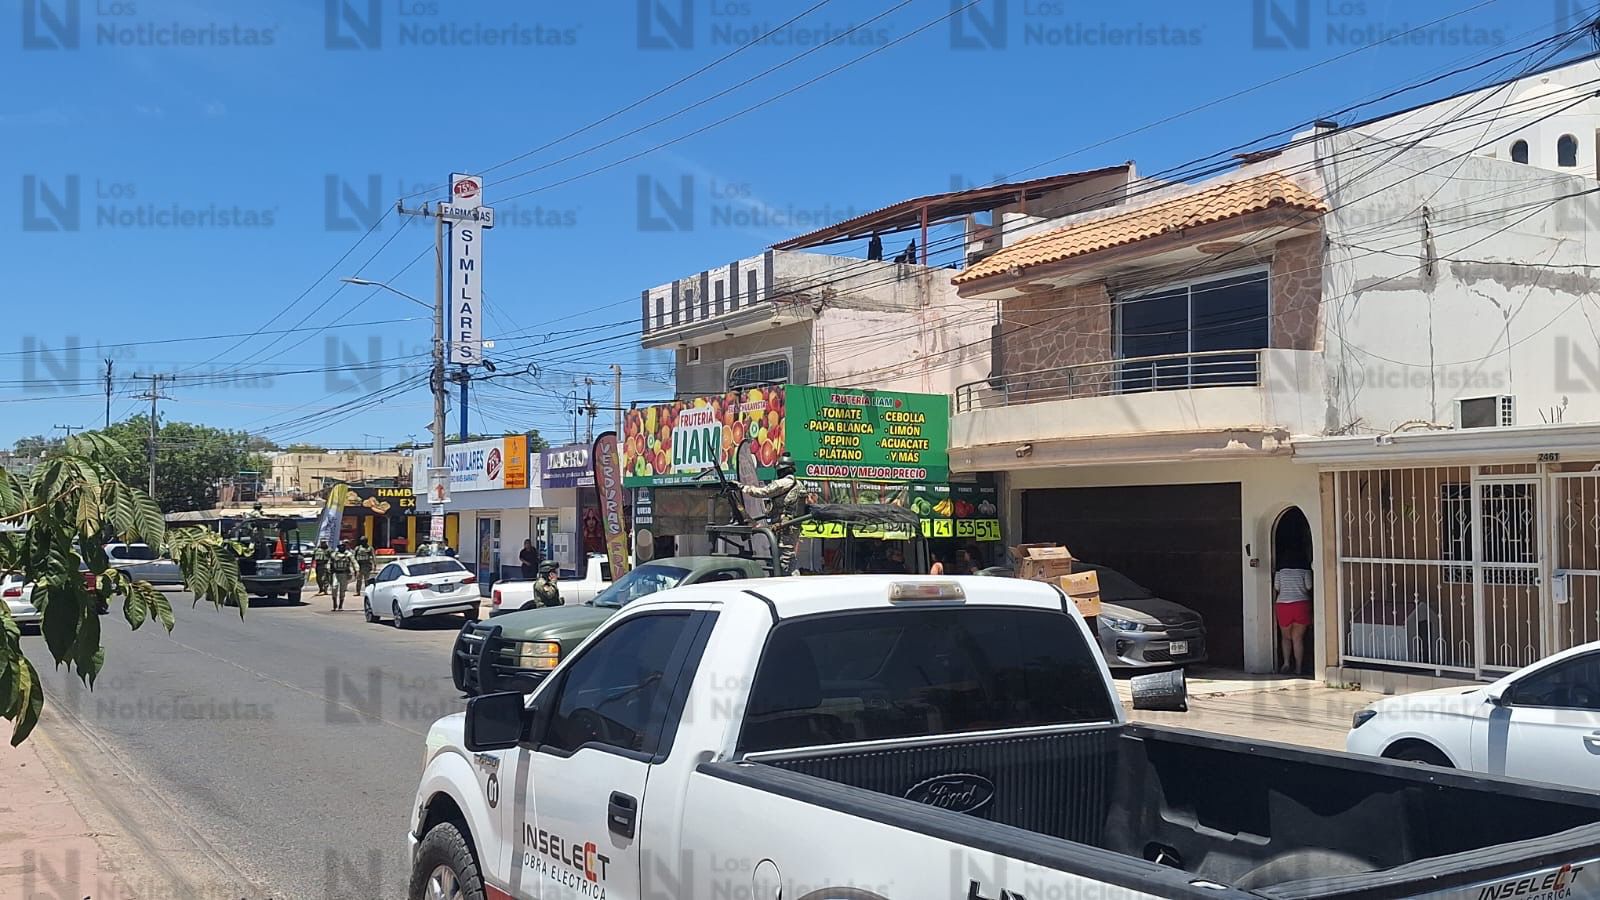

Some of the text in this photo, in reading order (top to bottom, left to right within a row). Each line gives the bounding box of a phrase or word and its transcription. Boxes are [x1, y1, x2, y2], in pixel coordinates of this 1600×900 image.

[458, 229, 475, 358] SIMILARES
[831, 393, 893, 407] FRUTERÍA LIAM
[822, 407, 862, 420] TOMATE
[885, 411, 925, 424] CEBOLLA
[809, 420, 874, 434] PAPA BLANCA
[889, 424, 921, 436] LIMÓN
[672, 425, 721, 466] LIAM
[824, 435, 860, 447] PEPINO
[880, 438, 929, 450] AGUACATE
[819, 446, 863, 460] PLÁTANO
[890, 450, 920, 463] Y MÁS
[455, 450, 484, 472] SIMILARES
[806, 464, 927, 479] CALIDAD Y MEJOR PRECIO
[600, 442, 620, 535] VERDURAS
[958, 521, 974, 535] 33
[488, 778, 498, 803] 01
[920, 780, 978, 808] Ford
[522, 821, 610, 882] INSELECT
[524, 853, 606, 900] OBRA ELÉCTRICA
[1479, 864, 1583, 900] INSELECT
